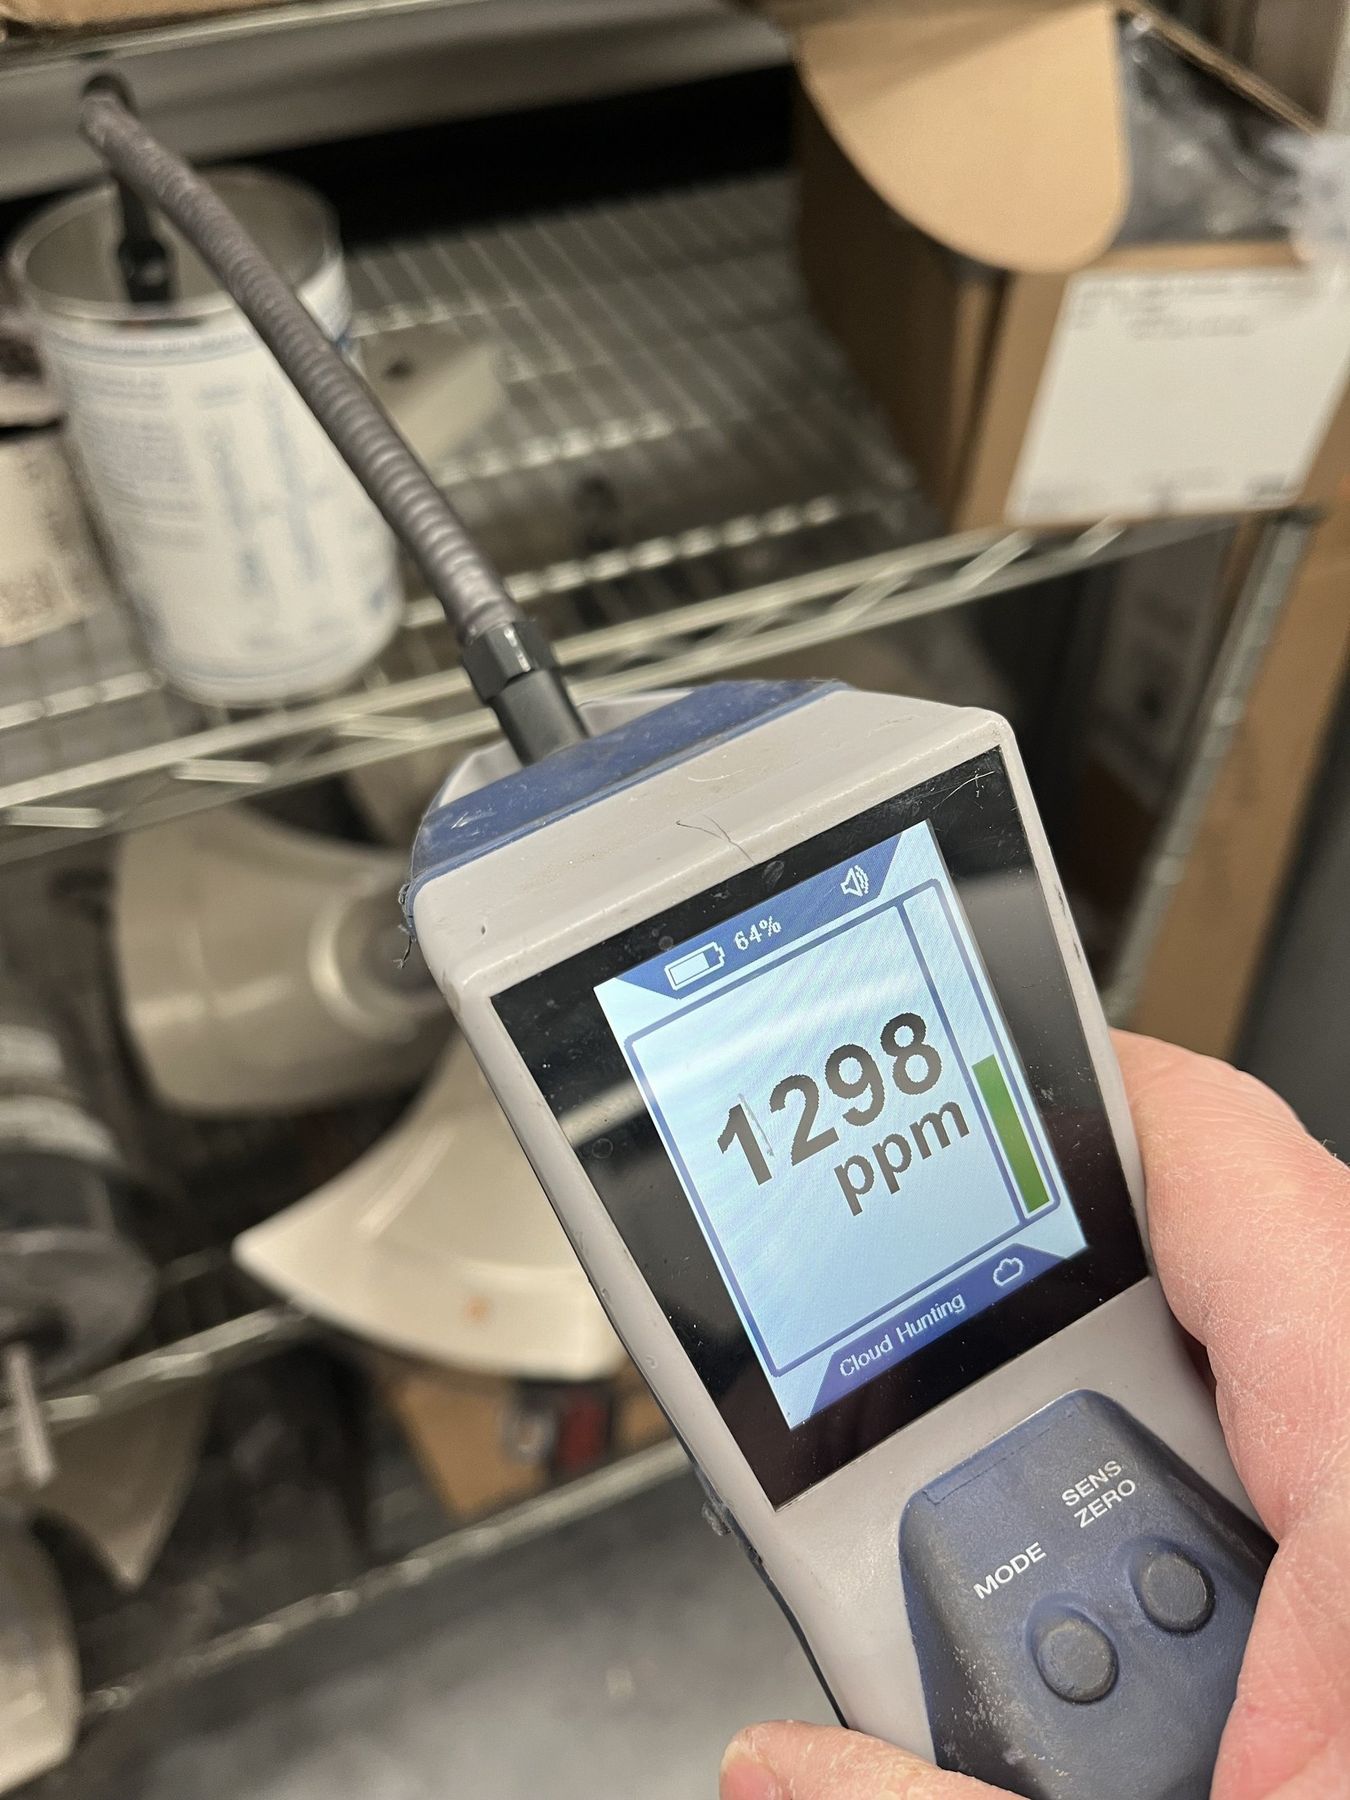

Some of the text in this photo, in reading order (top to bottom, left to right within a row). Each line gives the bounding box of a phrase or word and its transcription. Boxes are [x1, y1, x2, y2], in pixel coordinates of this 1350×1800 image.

[734, 916, 781, 950] 64%
[718, 1012, 942, 1186] 1298
[833, 1101, 970, 1216] ppm
[839, 1293, 965, 1377] Cloud Hunting
[1061, 1460, 1122, 1507] SENS
[1074, 1479, 1136, 1528] ZERO
[973, 1542, 1046, 1599] MODE
